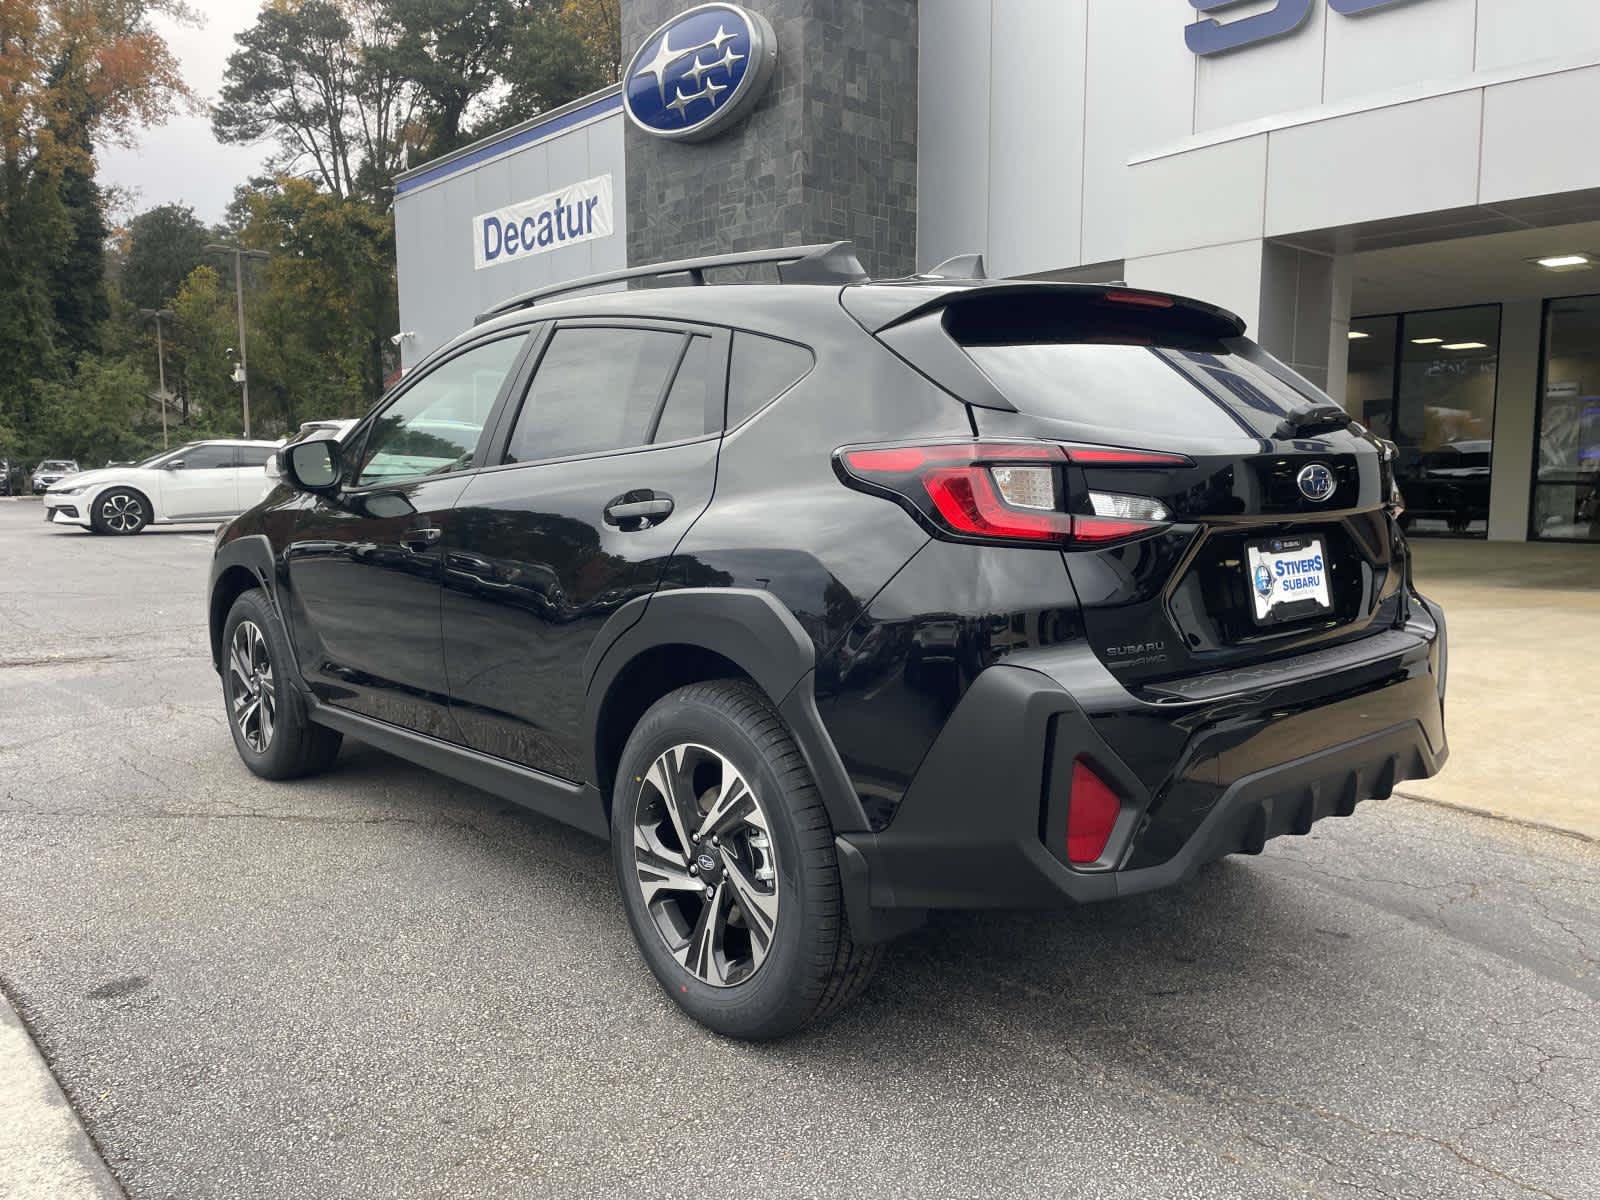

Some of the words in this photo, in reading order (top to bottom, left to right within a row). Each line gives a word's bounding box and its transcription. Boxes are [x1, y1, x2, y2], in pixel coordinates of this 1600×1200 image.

[483, 195, 598, 261] Decatur
[1275, 555, 1323, 576] STIVERS
[1282, 576, 1320, 592] SUBARU
[1106, 641, 1164, 656] SUBARU
